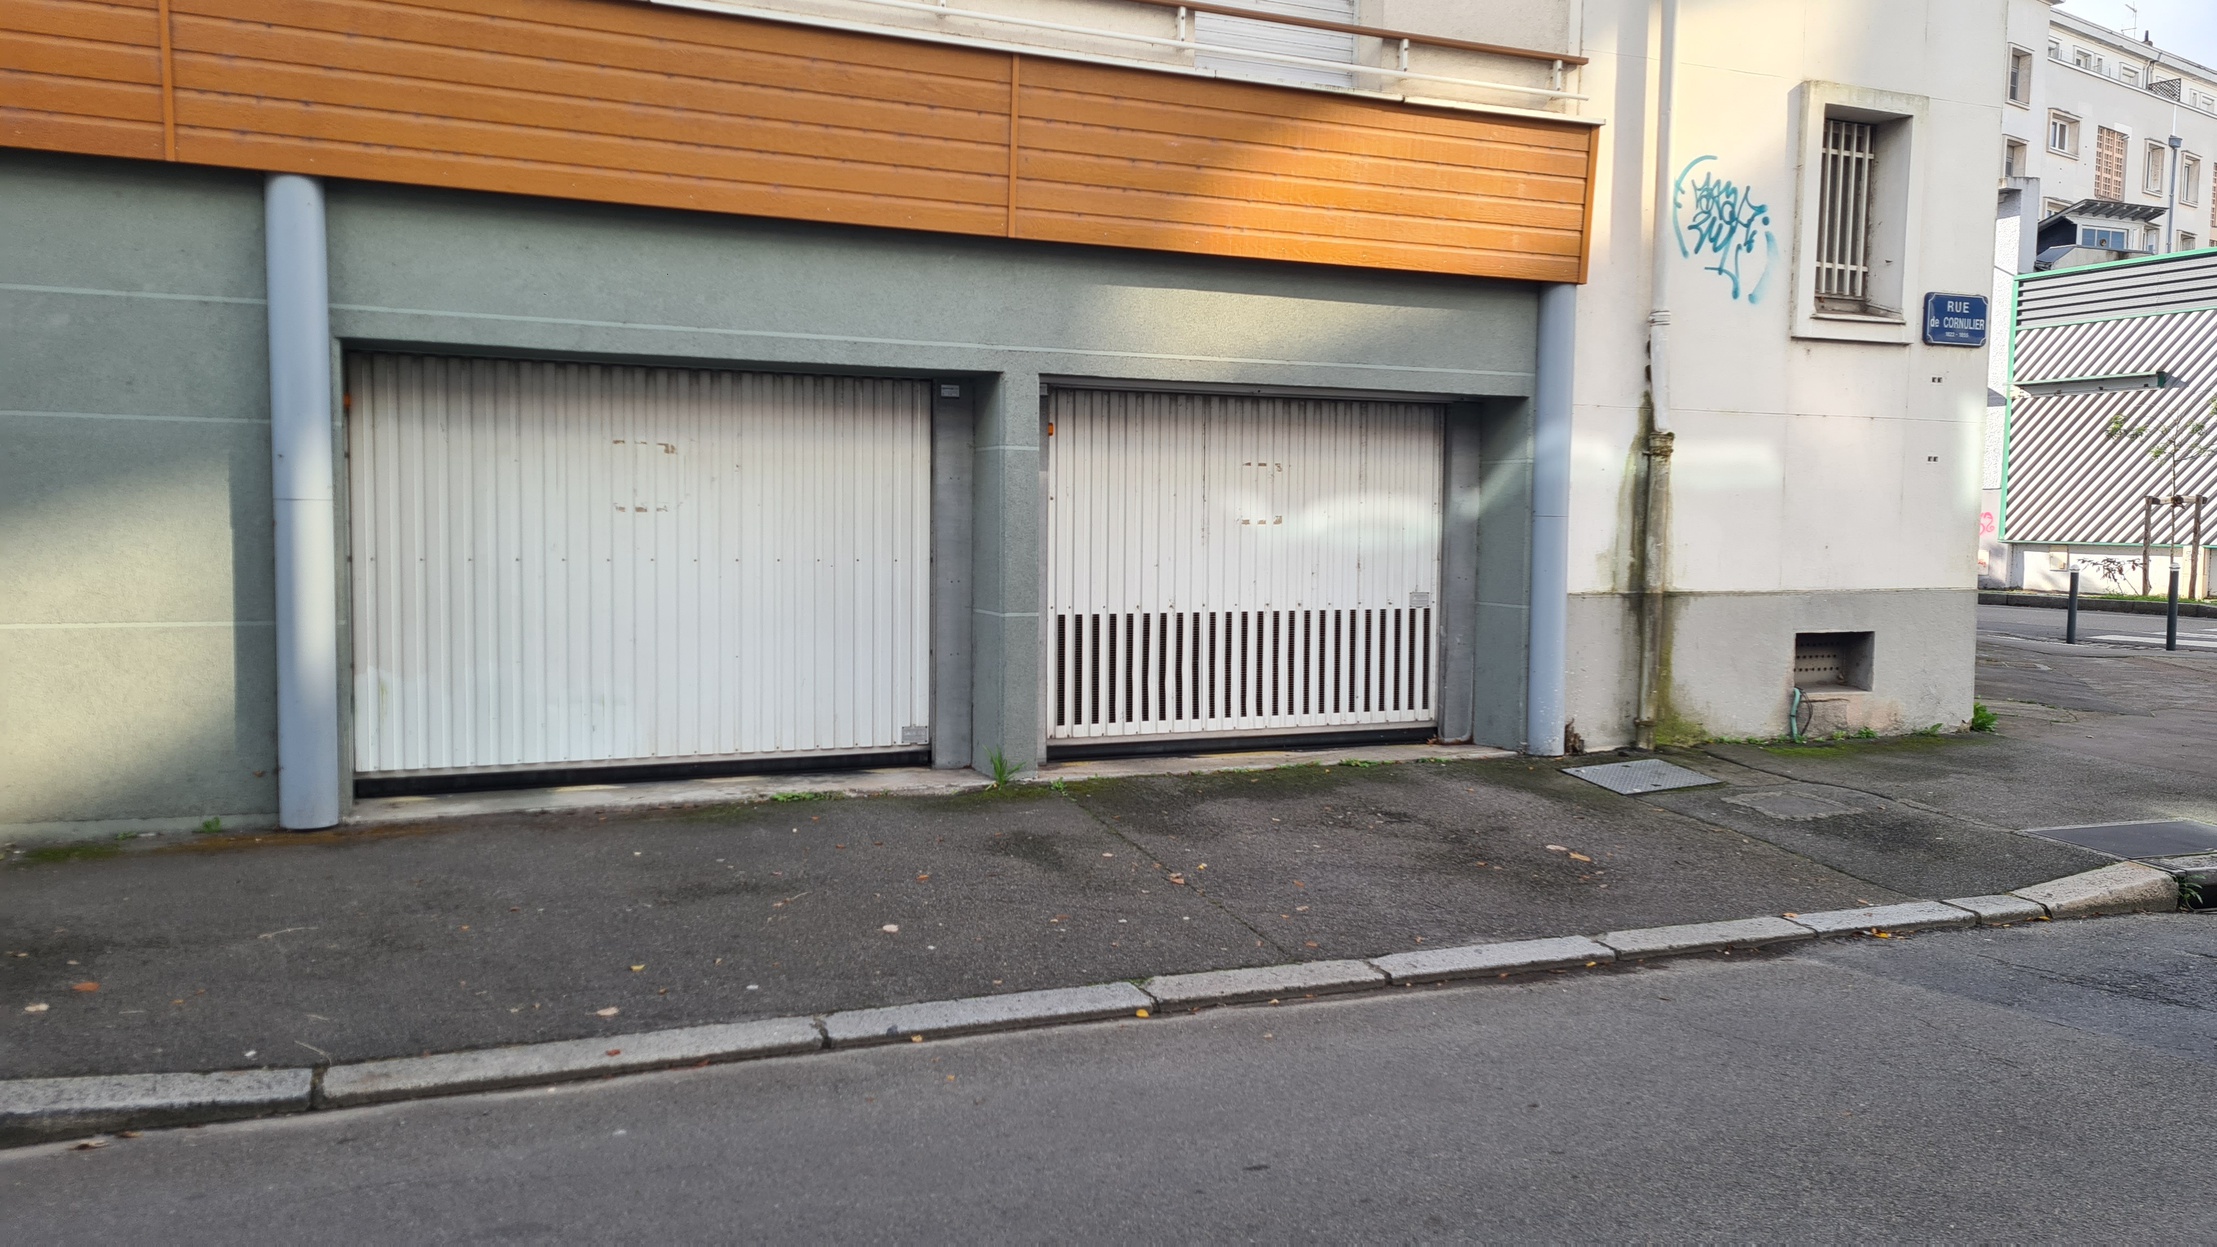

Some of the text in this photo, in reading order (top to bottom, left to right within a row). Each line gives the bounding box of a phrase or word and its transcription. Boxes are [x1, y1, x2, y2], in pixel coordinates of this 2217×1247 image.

[1947, 300, 1970, 313] RUE
[1930, 316, 1985, 330] de CORNULIER
